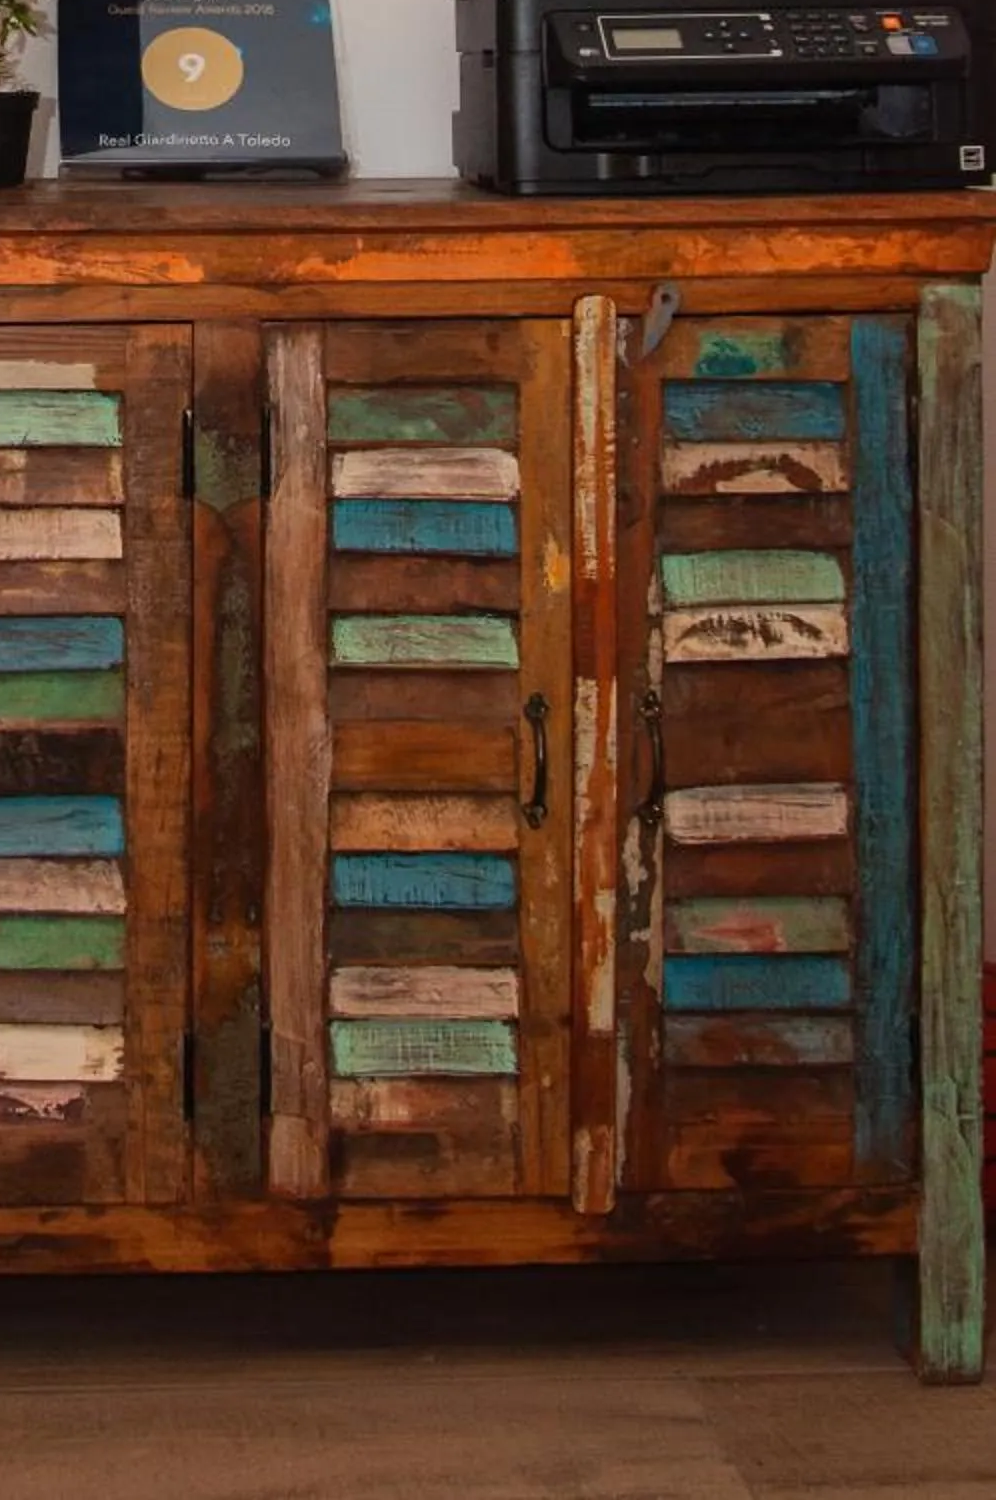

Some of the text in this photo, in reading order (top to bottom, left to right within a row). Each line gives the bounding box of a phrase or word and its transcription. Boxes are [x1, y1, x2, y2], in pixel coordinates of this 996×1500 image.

[177, 51, 206, 82] 9
[98, 133, 131, 147] Real
[222, 133, 235, 147] A
[237, 133, 291, 147] Toledo
